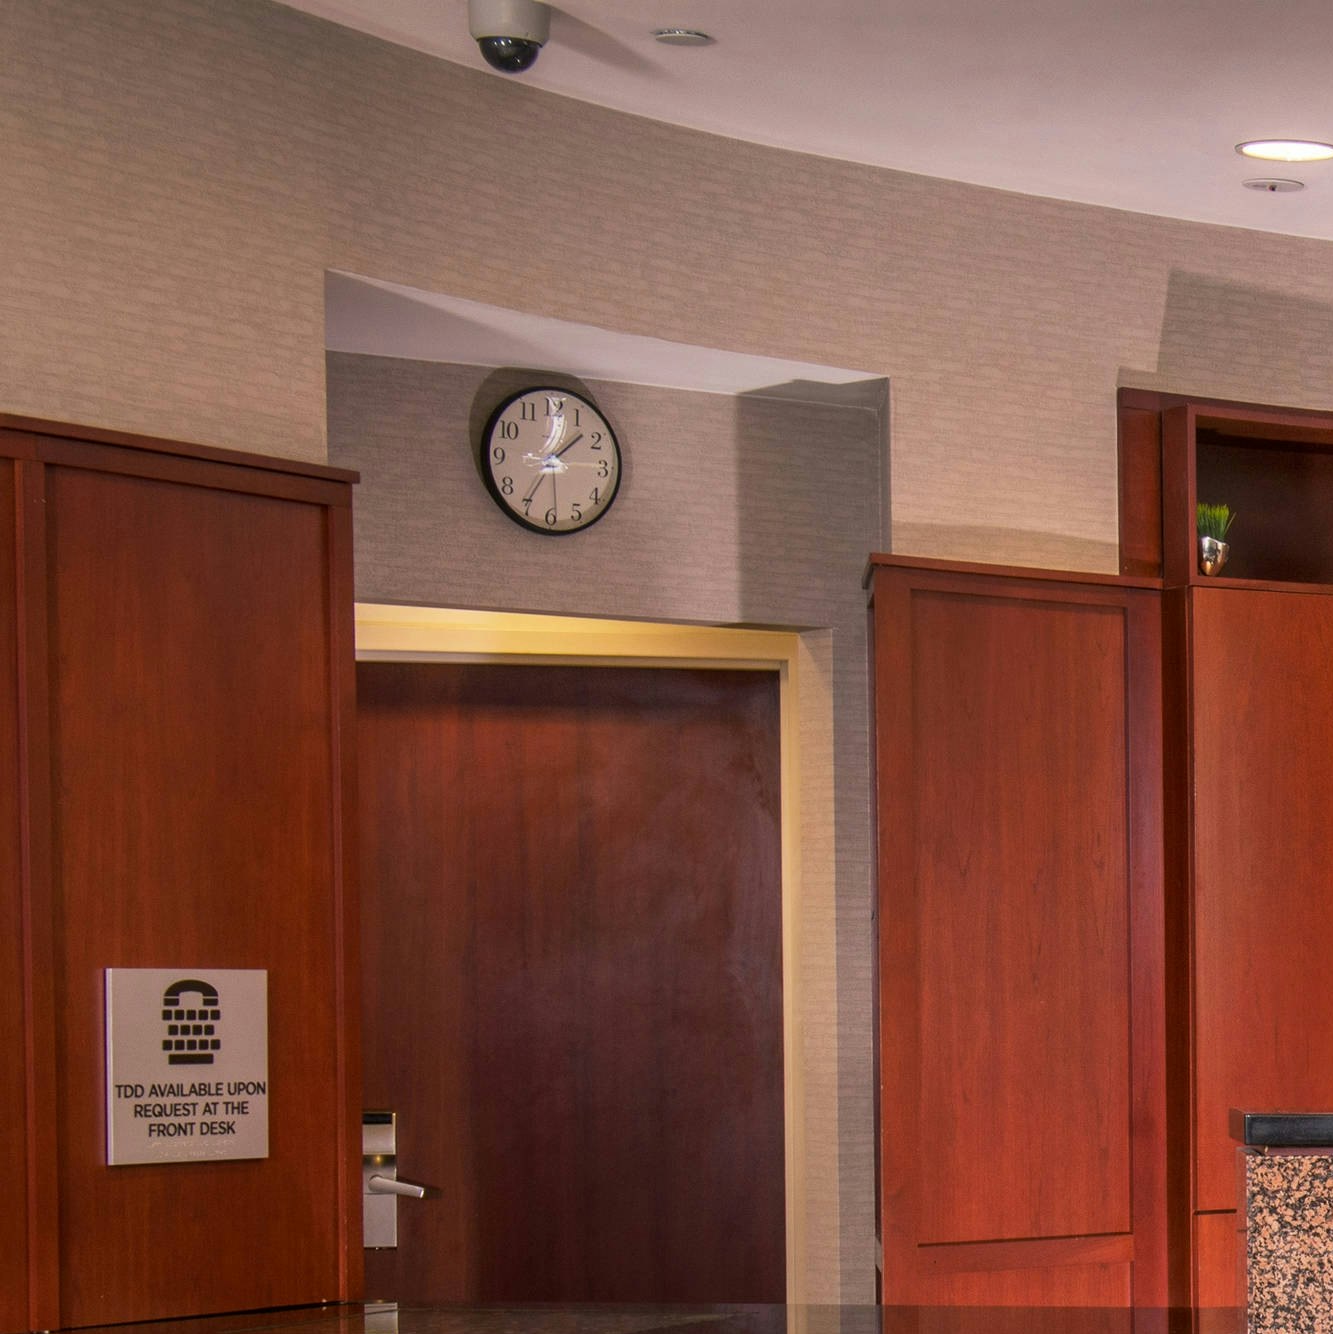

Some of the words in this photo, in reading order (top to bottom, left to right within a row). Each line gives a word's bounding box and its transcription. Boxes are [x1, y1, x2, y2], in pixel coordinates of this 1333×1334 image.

[520, 402, 537, 421] 11
[544, 398, 565, 418] 12
[573, 408, 581, 427] 1
[499, 420, 519, 440] 10
[590, 432, 602, 450] 2
[493, 447, 506, 465] 9
[597, 459, 609, 478] 3
[501, 476, 514, 495] 8
[589, 487, 602, 505] 4
[522, 498, 533, 516] 7
[570, 503, 582, 522] 5
[545, 508, 557, 526] 6
[115, 1084, 144, 1099] TDD
[148, 1082, 224, 1098] AVAILABLE
[228, 1081, 266, 1097] UPON
[134, 1103, 199, 1119] REQUEST
[202, 1102, 218, 1116] AT
[223, 1101, 249, 1115] THE
[148, 1123, 195, 1137] FRONT
[200, 1121, 236, 1136] DESK
